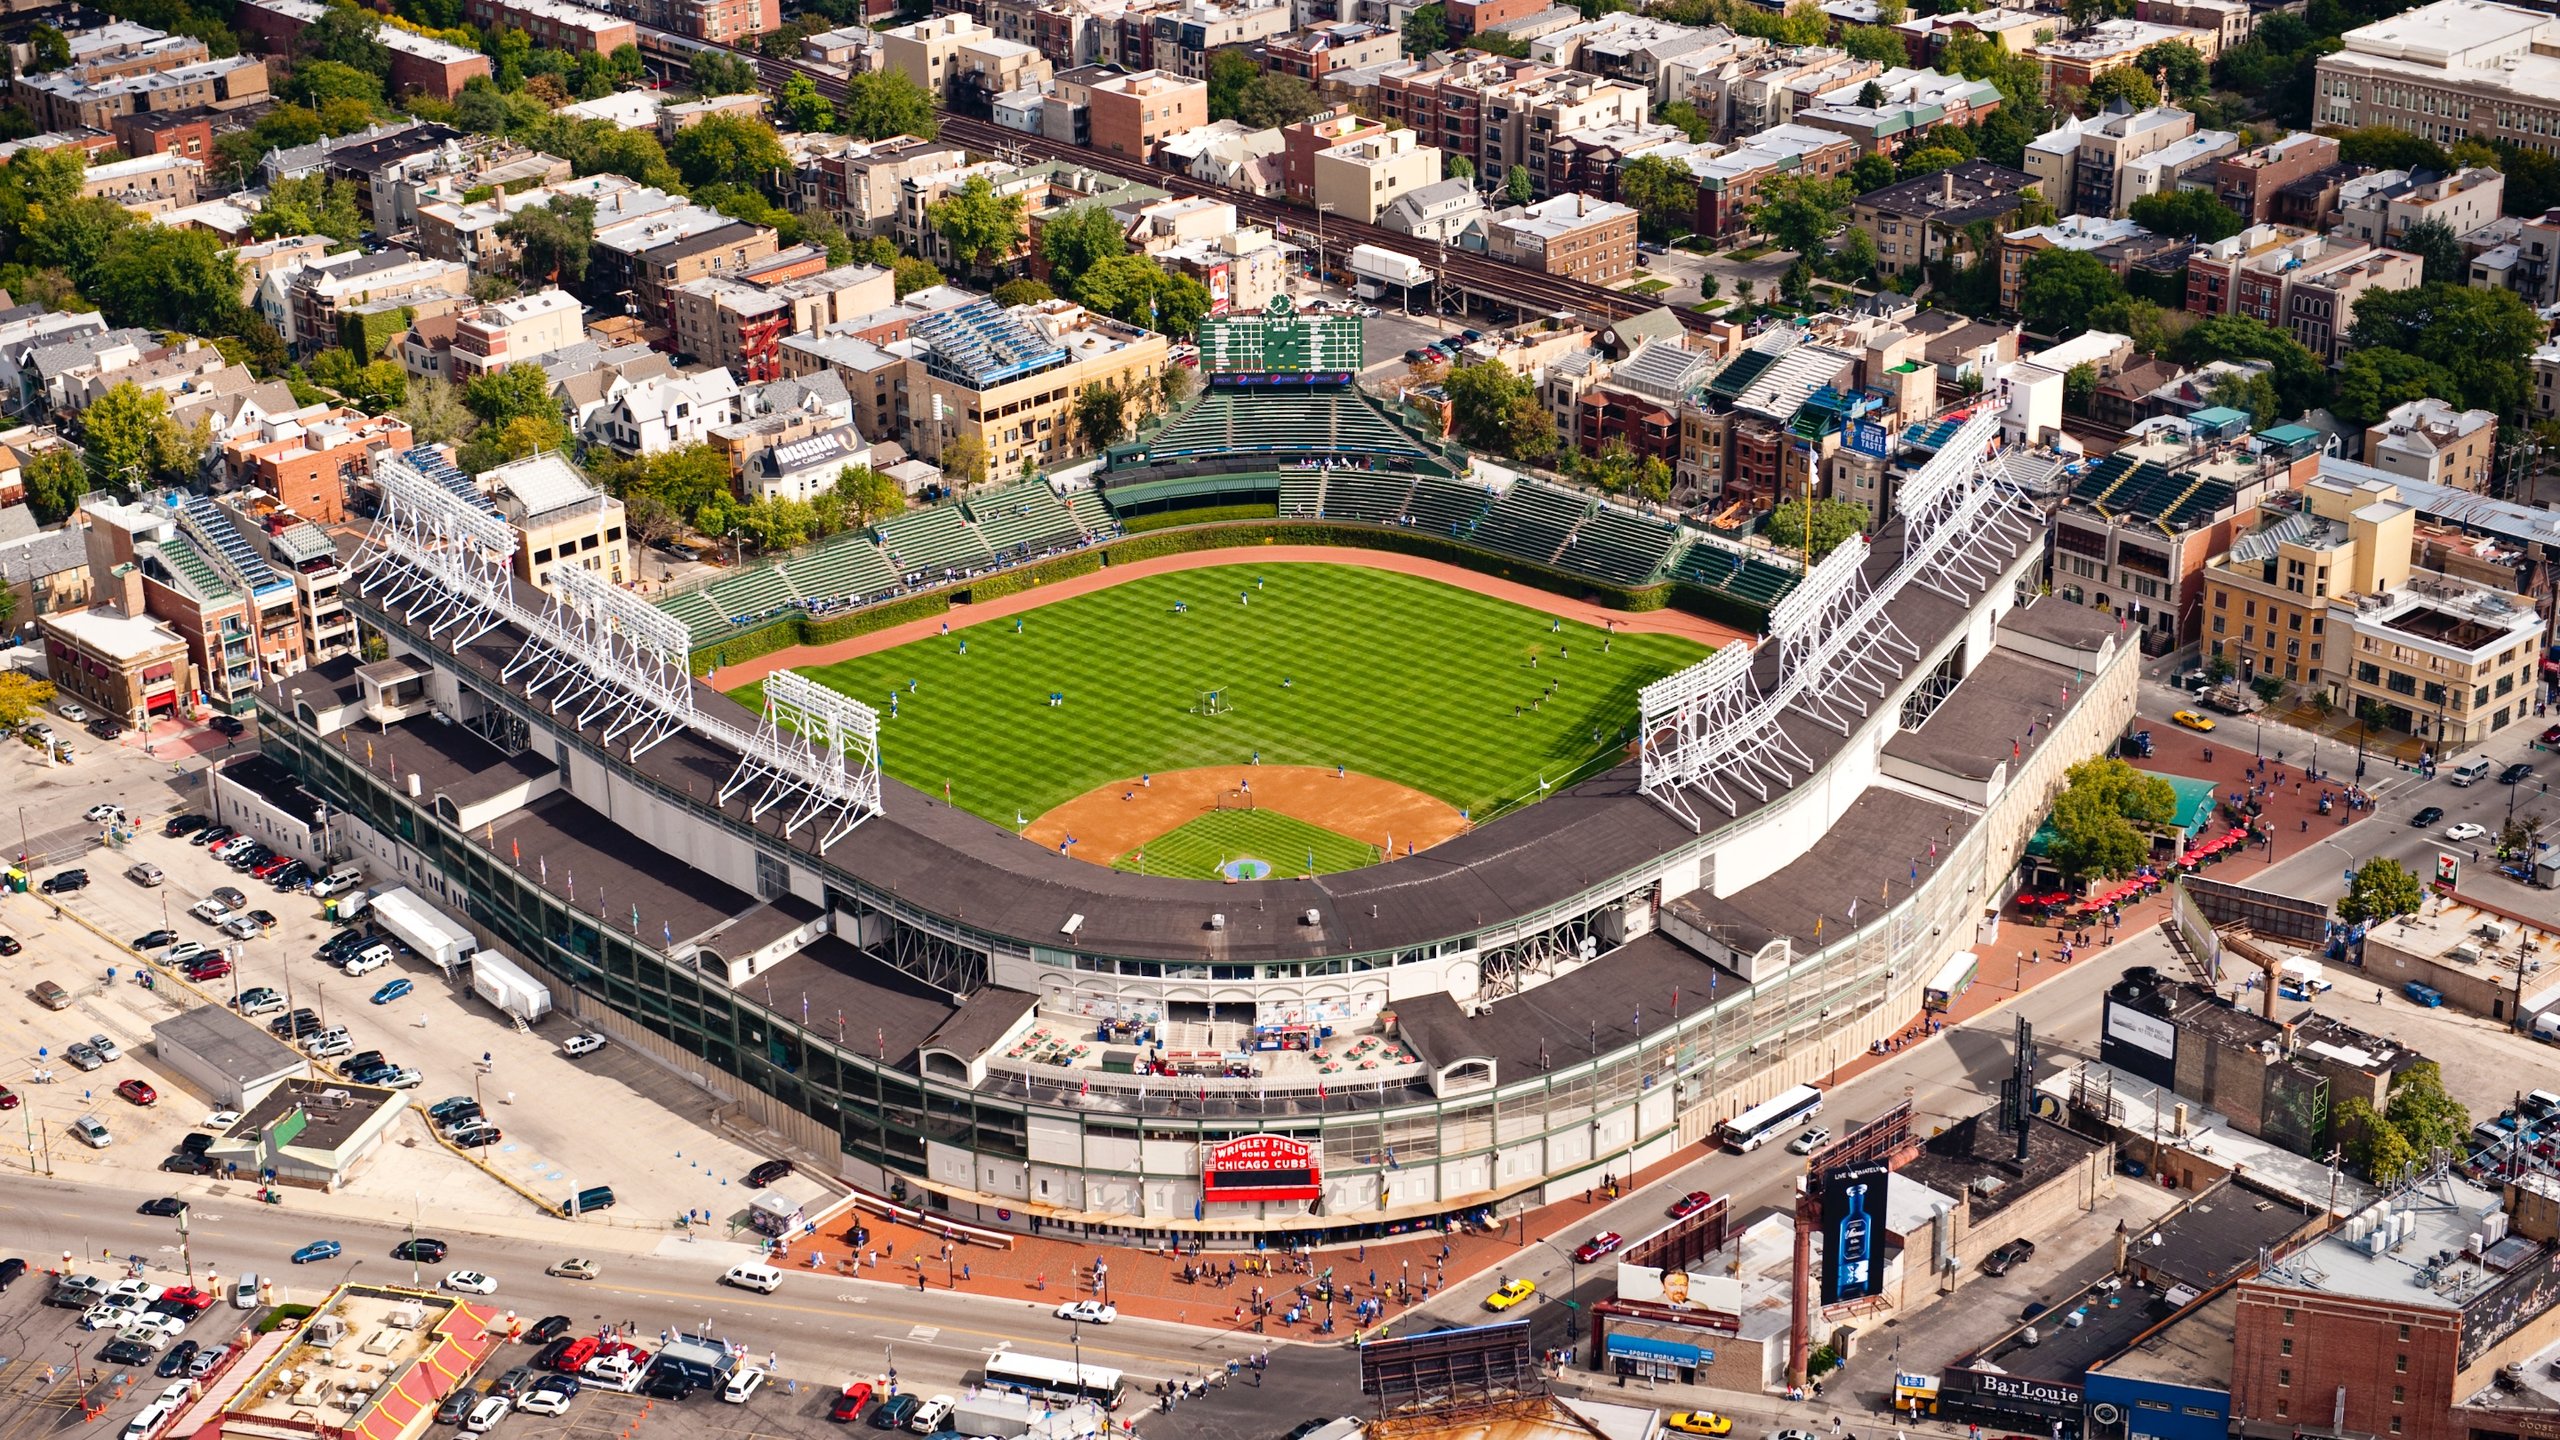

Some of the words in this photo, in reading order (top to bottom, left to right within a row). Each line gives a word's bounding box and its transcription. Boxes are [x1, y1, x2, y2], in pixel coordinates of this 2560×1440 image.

[1860, 431, 1883, 444] GREAT
[775, 433, 840, 464] HORSESHOE
[1860, 440, 1883, 452] TASTE
[802, 453, 826, 464] CASINO
[2440, 856, 2454, 878] 7
[1216, 1138, 1269, 1159] WRIGLEY
[1272, 1139, 1307, 1156] FIELD
[1217, 1159, 1270, 1171] CHICAGO
[1274, 1158, 1307, 1170] CUBS
[1834, 1171, 1847, 1180] LIVE
[1628, 1350, 1652, 1358] SPORTS
[1653, 1353, 1675, 1362] WORLD
[1983, 1375, 2020, 1394] Bar
[2021, 1381, 2079, 1403] Louie
[2519, 1421, 2554, 1432] GOOSE
